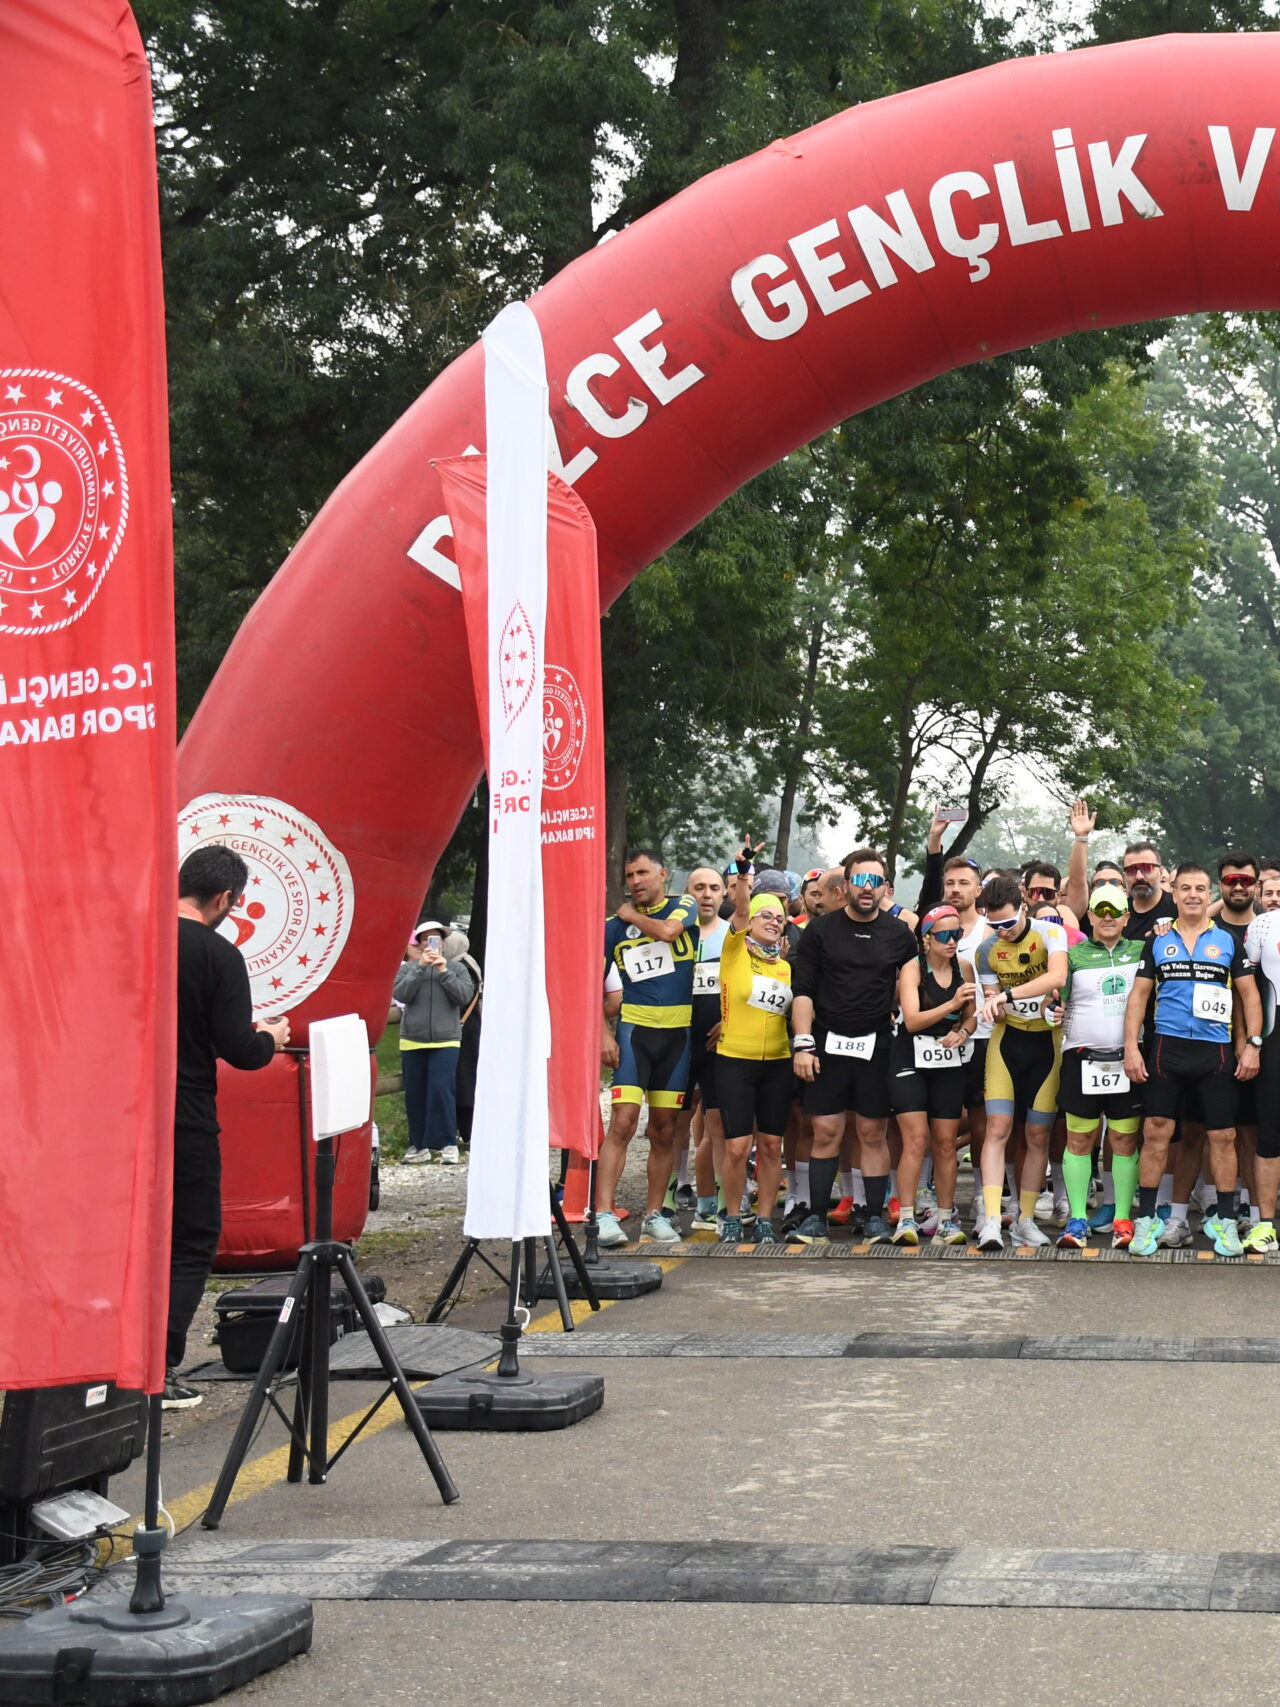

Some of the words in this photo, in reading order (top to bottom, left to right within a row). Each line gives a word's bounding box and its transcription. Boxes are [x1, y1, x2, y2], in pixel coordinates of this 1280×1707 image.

[406, 309, 705, 592] DCE
[731, 127, 1165, 341] GENÇLİK
[231, 839, 285, 872] GENÇLİK
[284, 872, 299, 887] VE
[291, 891, 304, 926] SPOR
[249, 929, 298, 972] BAKANLI
[634, 956, 664, 975] 117
[693, 976, 716, 988] 16
[758, 991, 786, 1008] 142
[1202, 1000, 1226, 1015] 045
[835, 1041, 866, 1052] 188
[923, 1049, 953, 1062] 050
[1091, 1074, 1121, 1087] 167
